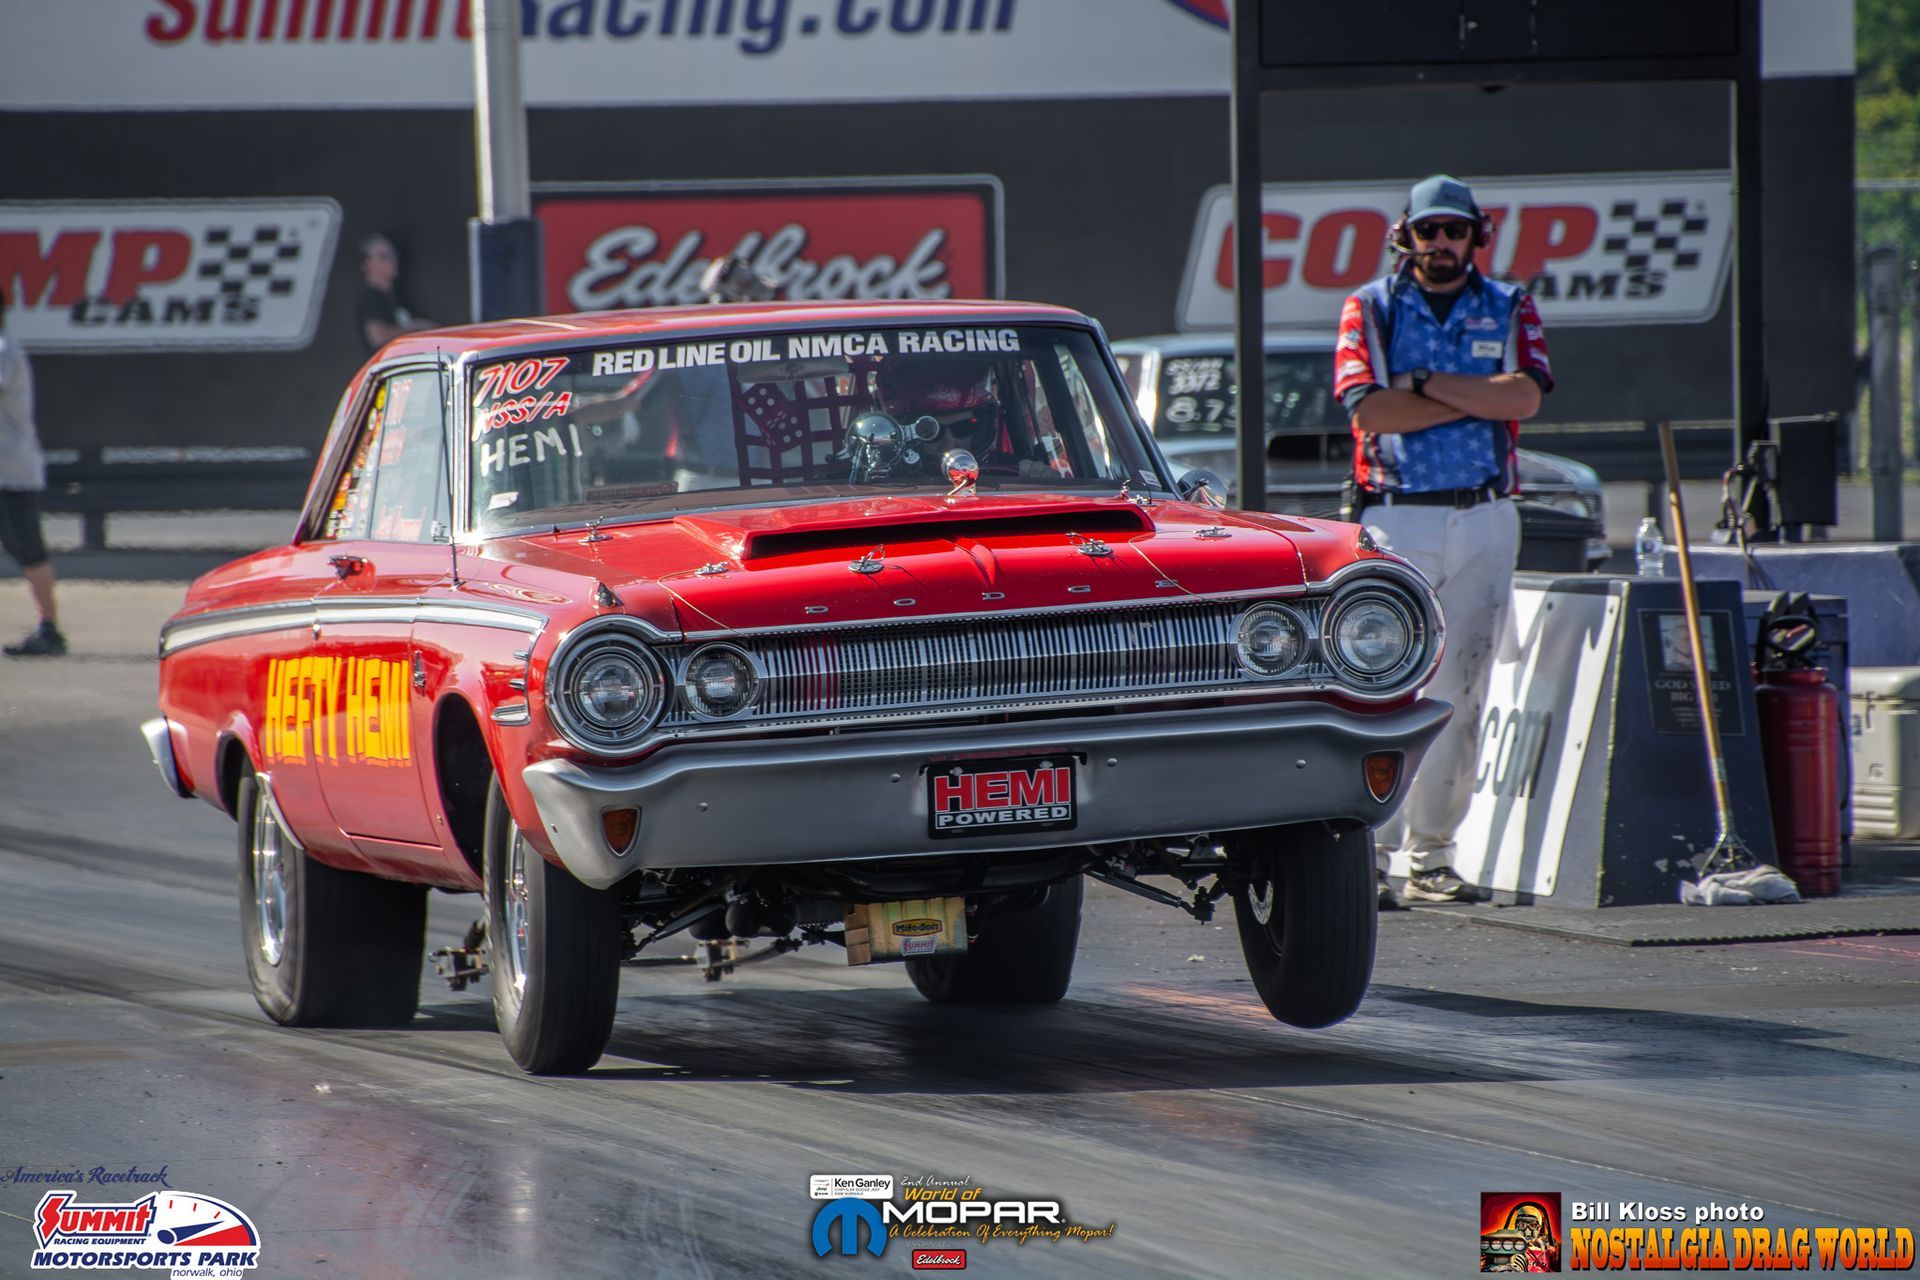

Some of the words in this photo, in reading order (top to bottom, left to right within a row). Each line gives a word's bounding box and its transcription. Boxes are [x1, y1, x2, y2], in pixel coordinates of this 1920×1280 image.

[1215, 206, 1598, 290] COP
[1495, 270, 1667, 299] AMS
[69, 296, 262, 328] CAMS
[592, 349, 656, 377] RED
[658, 341, 726, 370] LINE
[730, 338, 781, 364] OIL
[788, 332, 889, 360] NMCA
[898, 329, 1020, 354] RACING
[472, 356, 570, 408] 7107
[472, 391, 573, 442] NSS/A
[480, 423, 583, 477] HEMI
[265, 656, 343, 766] HEFTY
[346, 656, 412, 767] HEMI
[934, 767, 1071, 812] HEMI
[938, 806, 1068, 827] POWERED
